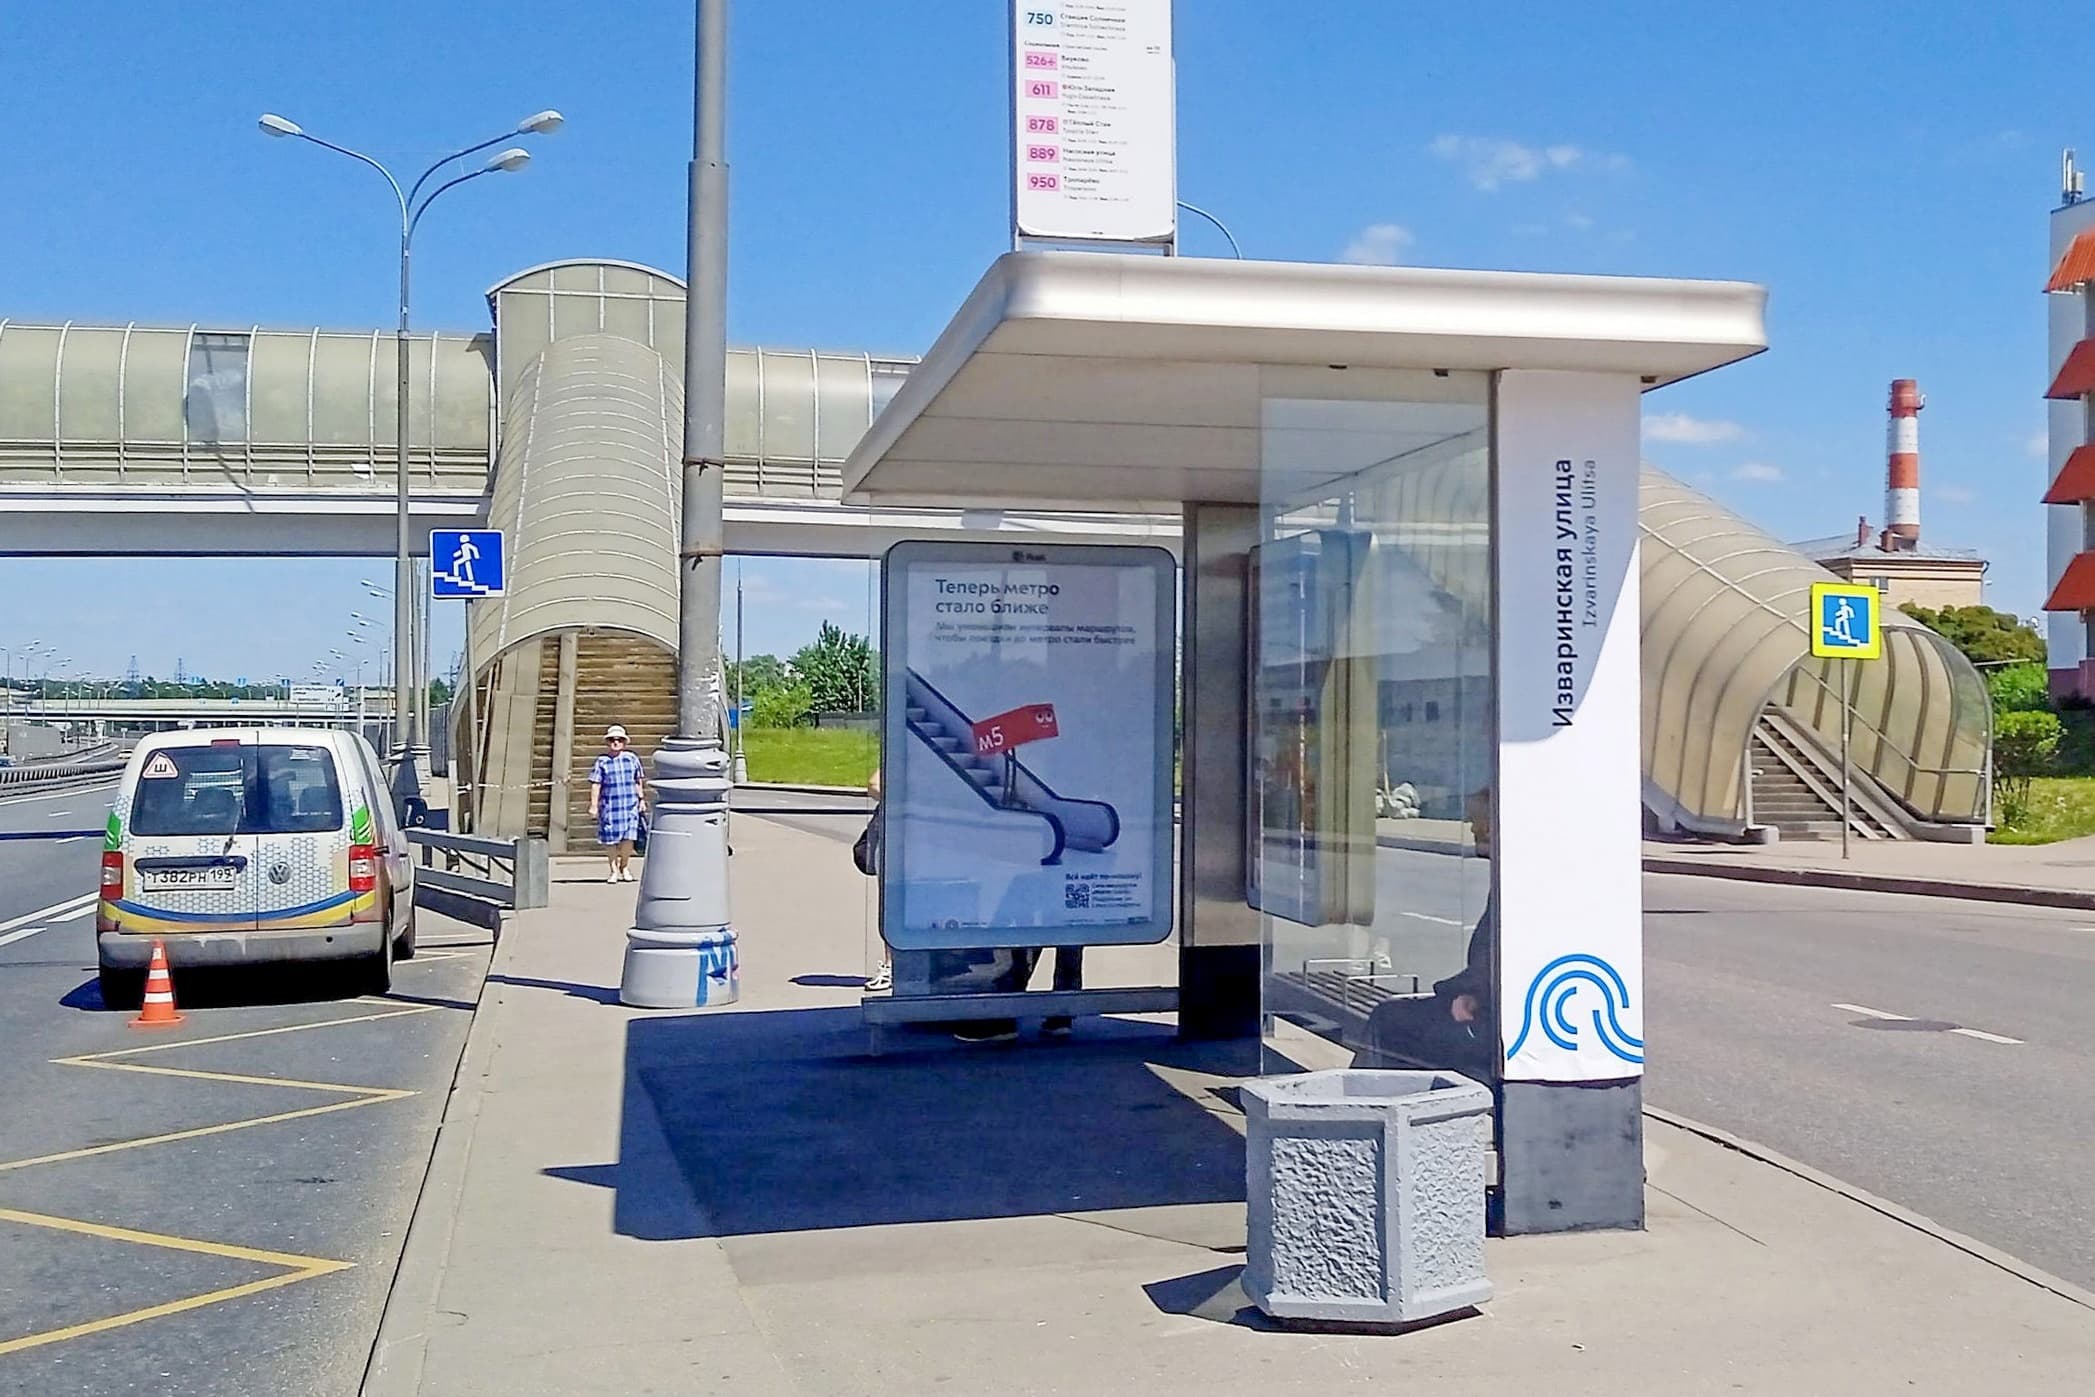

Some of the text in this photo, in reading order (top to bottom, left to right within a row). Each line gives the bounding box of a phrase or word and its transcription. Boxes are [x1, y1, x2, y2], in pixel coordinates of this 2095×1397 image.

[1027, 12, 1054, 25] 750
[1026, 55, 1056, 66] 526+
[1032, 84, 1051, 96] 611
[1029, 119, 1055, 131] 878
[1030, 147, 1056, 159] 889
[1030, 176, 1056, 188] 950
[1579, 459, 1599, 628] Izvarinskaya Ulitsa
[935, 578, 1060, 599] Теперь метро
[1552, 459, 1578, 727] Изваринская улица
[935, 598, 1049, 615] стало ближе
